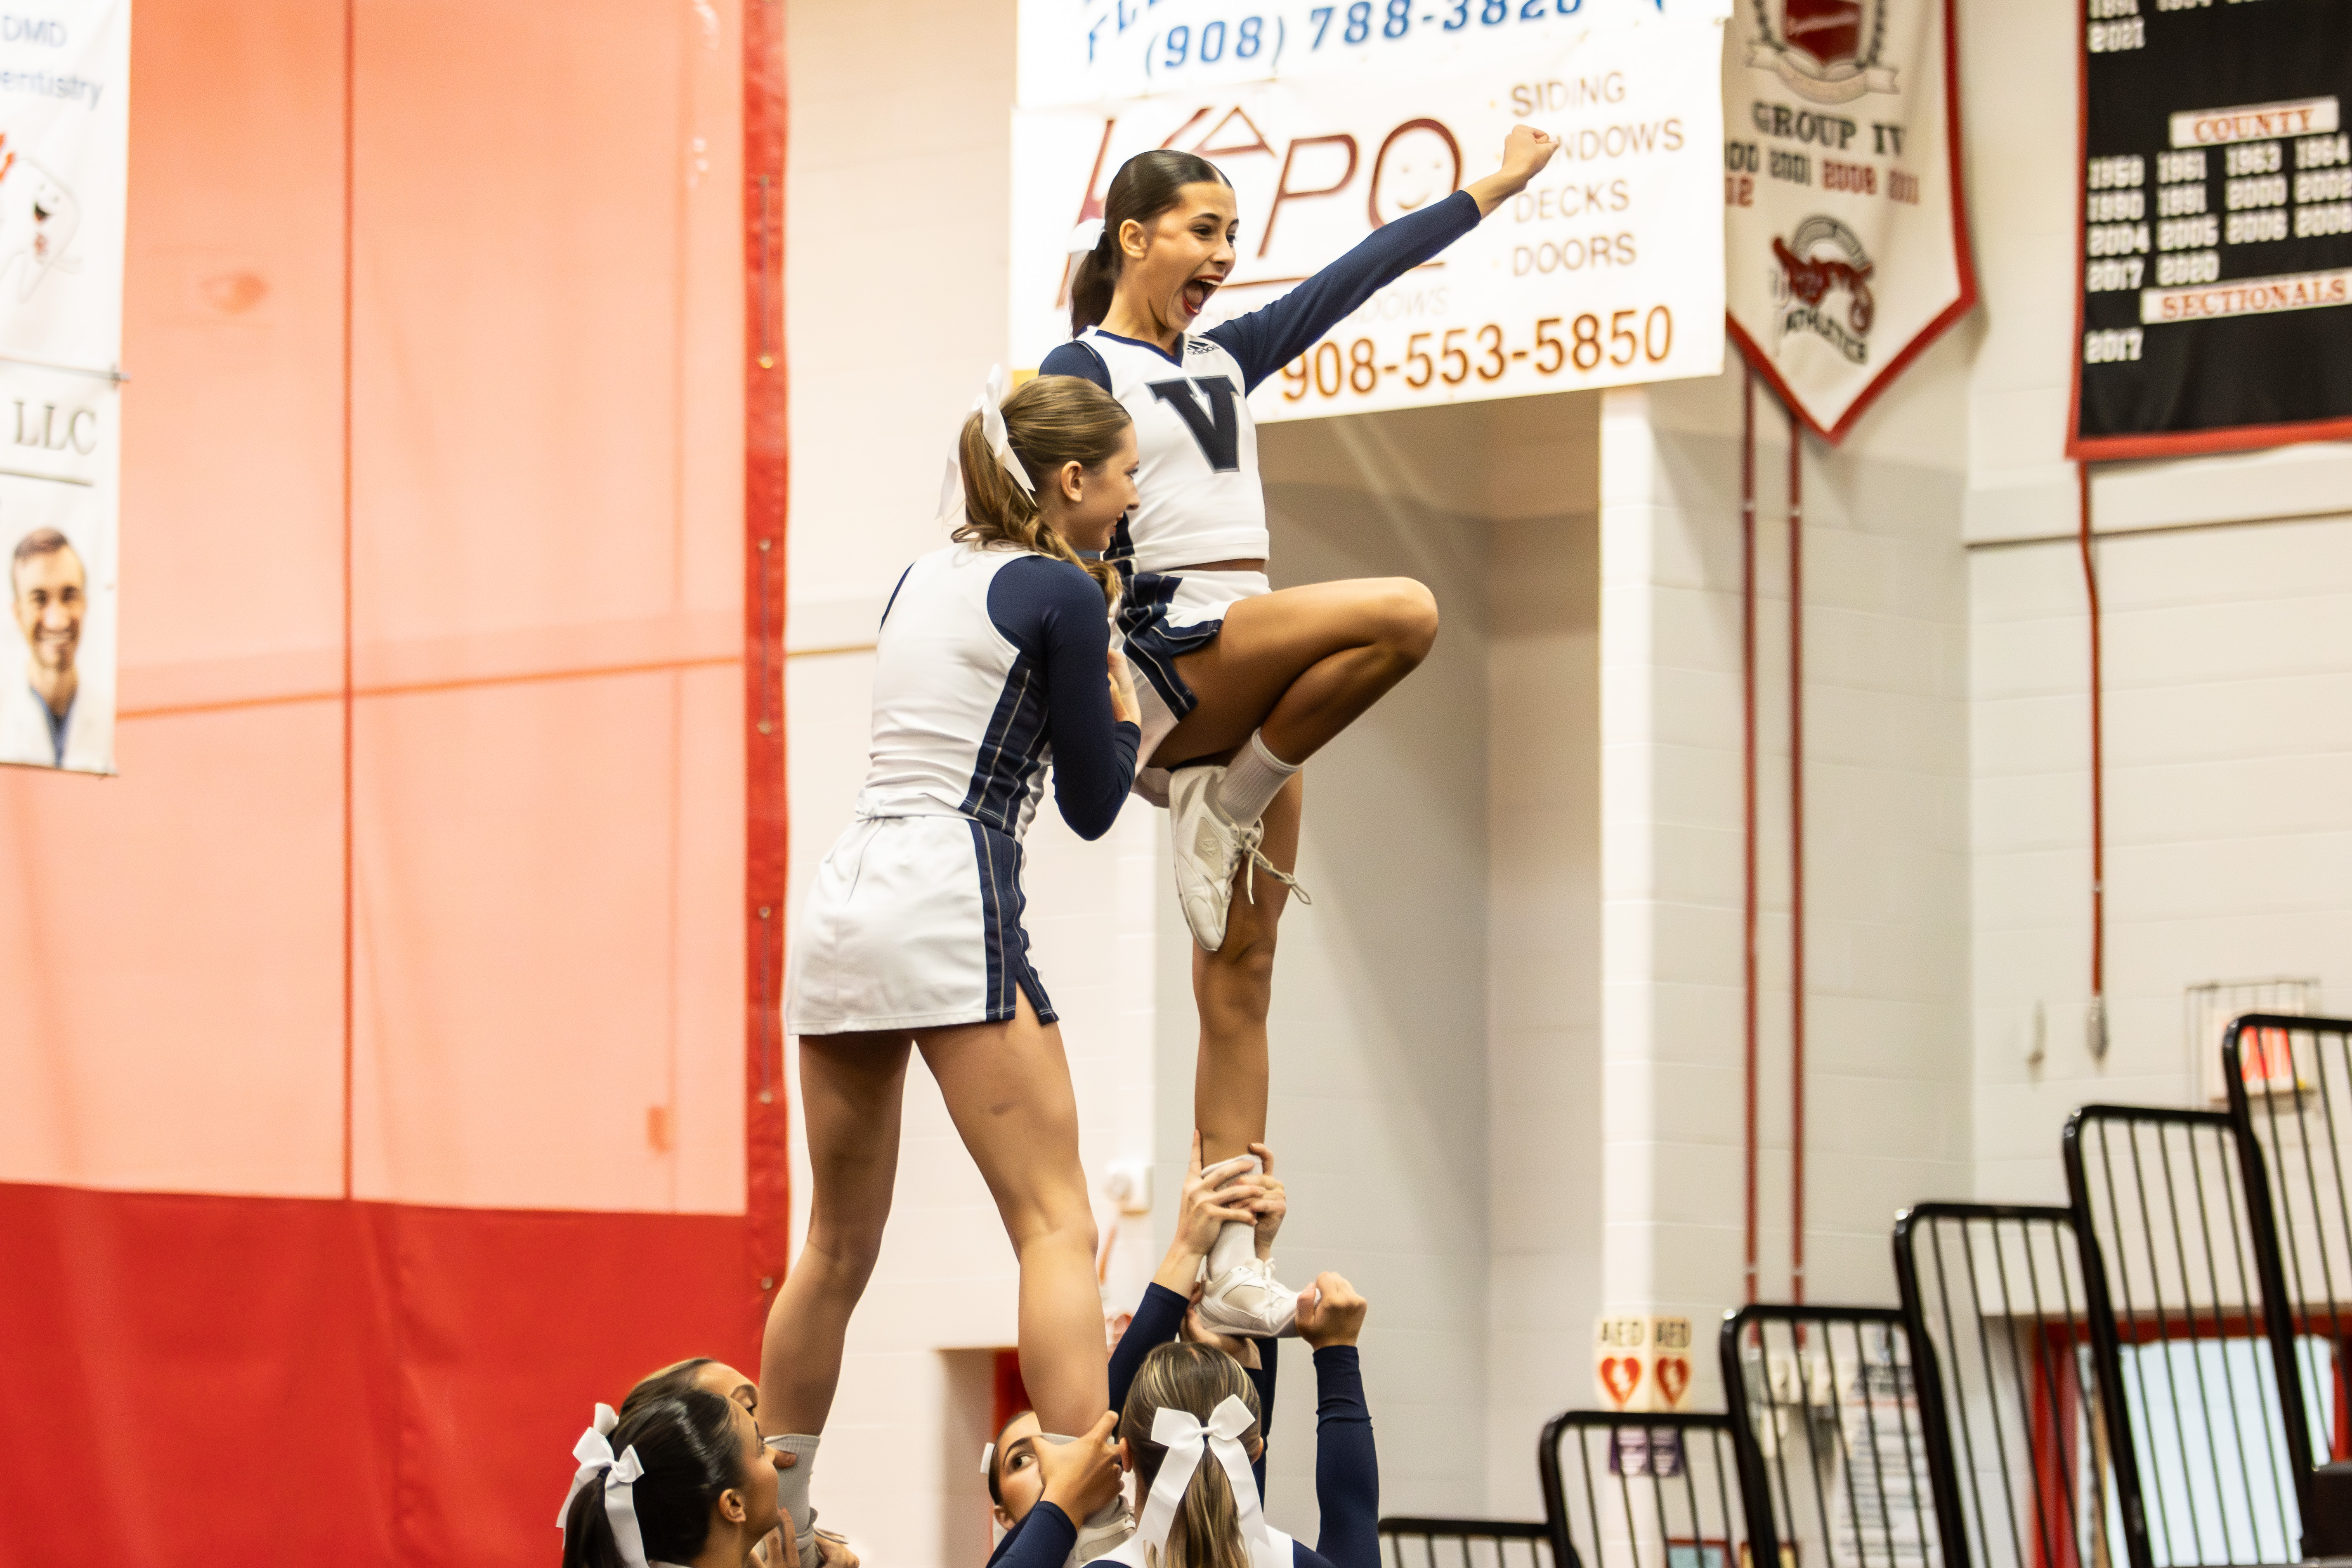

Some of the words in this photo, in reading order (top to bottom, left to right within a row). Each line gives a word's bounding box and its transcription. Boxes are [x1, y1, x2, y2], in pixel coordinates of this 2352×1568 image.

[3, 15, 68, 47] DMD
[1145, 16, 1285, 78] (908)
[0, 69, 104, 111] entistry
[1511, 71, 1626, 118] SIDING
[1553, 118, 1685, 162] NDOWS
[1752, 102, 1857, 150] GROUP
[1872, 123, 1907, 157] IV
[2194, 108, 2313, 143] COUNTY
[1724, 141, 1759, 173] 00
[1515, 179, 1629, 224] DECKS
[1513, 232, 1637, 276] DOORS
[2086, 256, 2144, 292] 2017
[2161, 278, 2347, 319] SECTIONALS
[1187, 344, 1220, 356] adidas
[1281, 305, 1673, 403] 908-553-5850
[2084, 327, 2144, 364] 2017
[14, 399, 97, 456] LLC
[1144, 375, 1240, 474] V
